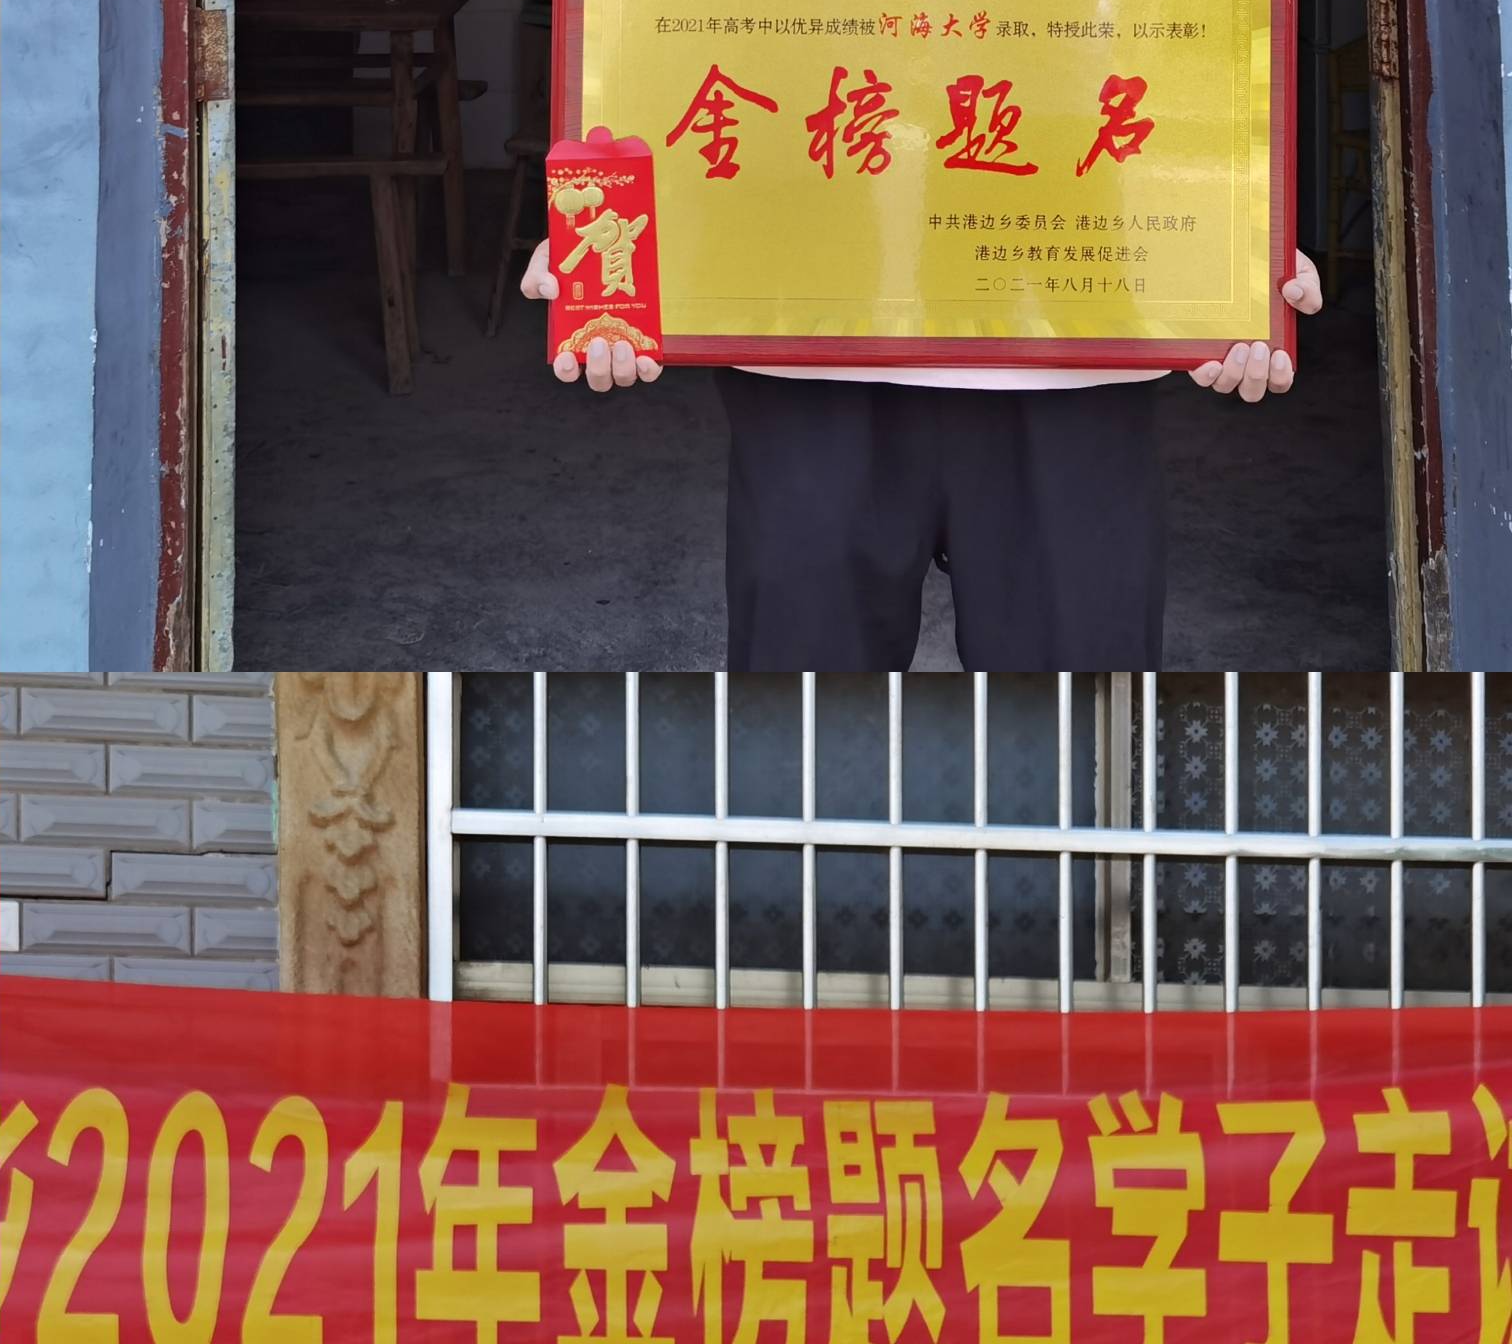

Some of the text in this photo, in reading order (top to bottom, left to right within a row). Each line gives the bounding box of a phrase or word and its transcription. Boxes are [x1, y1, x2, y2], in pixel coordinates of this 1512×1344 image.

[665, 64, 1155, 180] 金榜题名
[929, 214, 1197, 233] 中共港边乡委员会 港边乡人民政府
[975, 245, 1149, 262] 港边乡教育发展促进会
